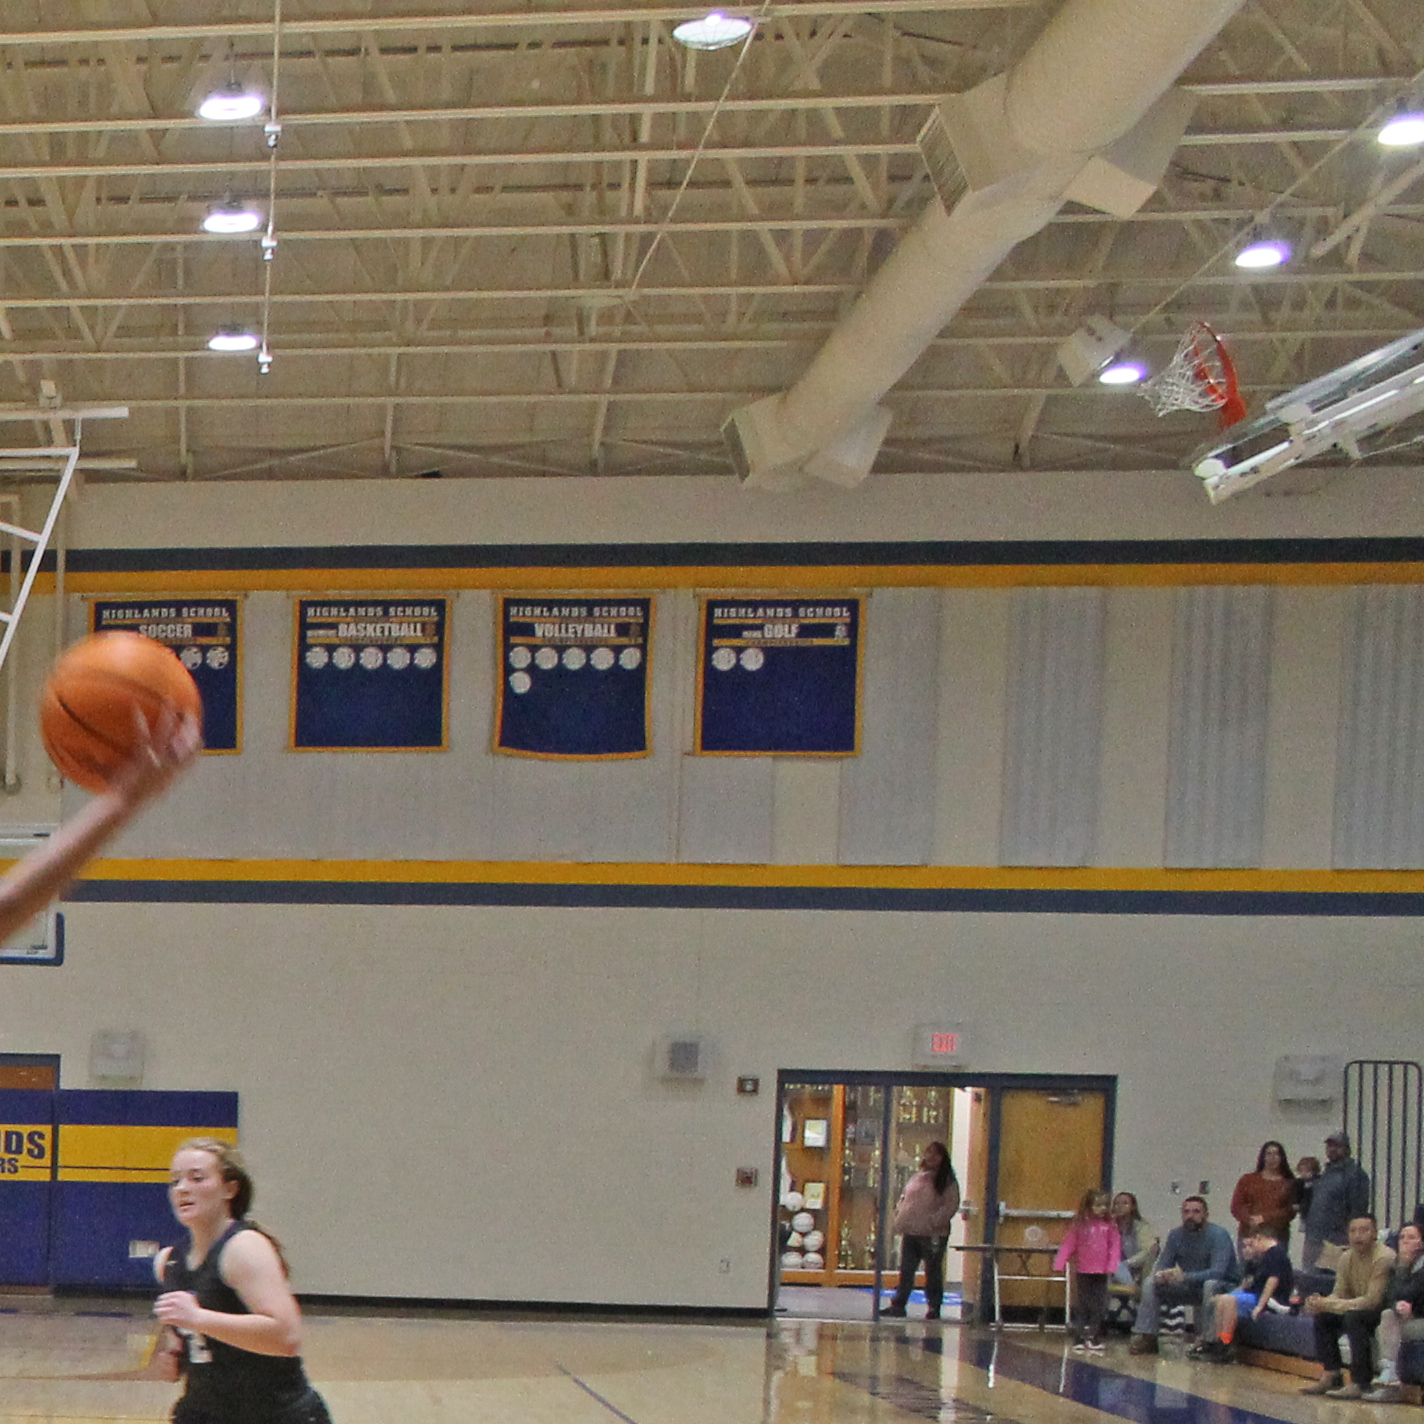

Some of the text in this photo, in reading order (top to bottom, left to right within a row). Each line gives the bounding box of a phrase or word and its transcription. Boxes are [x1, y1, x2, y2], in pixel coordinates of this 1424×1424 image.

[103, 607, 230, 619] HIGHLANDS SCHOOL
[307, 606, 438, 617] HIGHLANDS SCHOOL
[510, 606, 643, 617] HIGHLANDS SCHOOL
[714, 607, 850, 618] HIGHLANDS SCHOOL
[139, 624, 192, 638] SOCCER
[338, 623, 423, 637] BASKETBALL
[534, 623, 617, 637] VOLLEYBALL
[763, 624, 800, 638] GOLF
